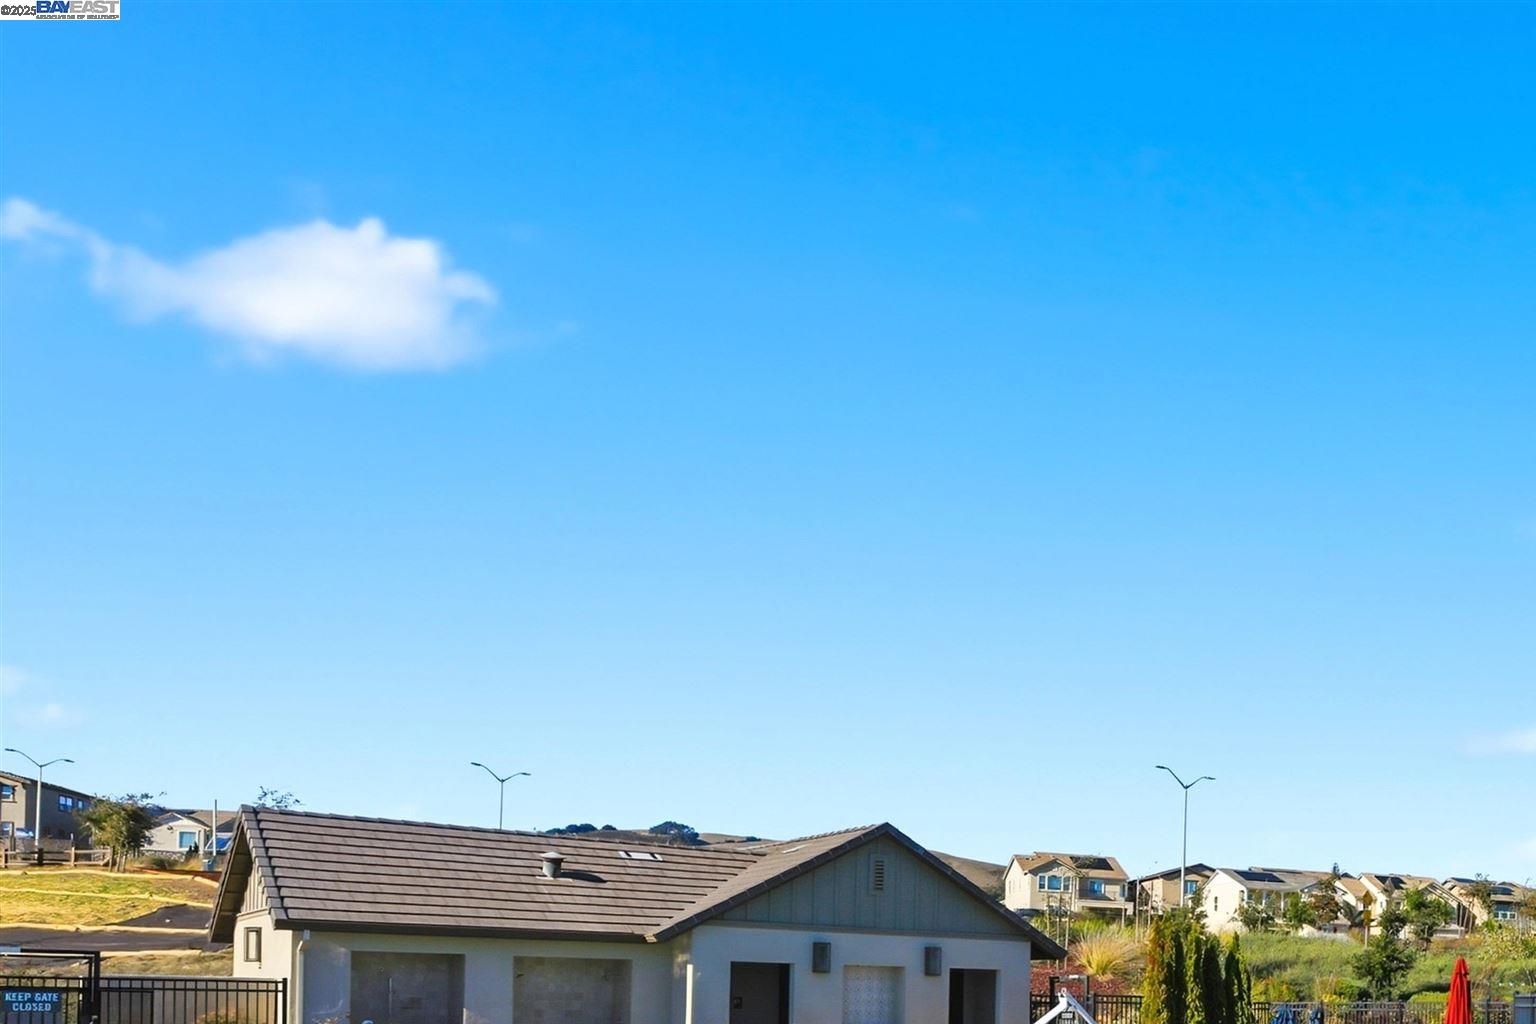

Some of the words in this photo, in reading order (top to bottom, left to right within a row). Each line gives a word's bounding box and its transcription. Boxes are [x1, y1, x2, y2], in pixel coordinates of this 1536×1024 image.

[5, 992, 32, 1001] KEEP
[34, 992, 59, 1001] GATE
[12, 1002, 52, 1011] CLOSED
